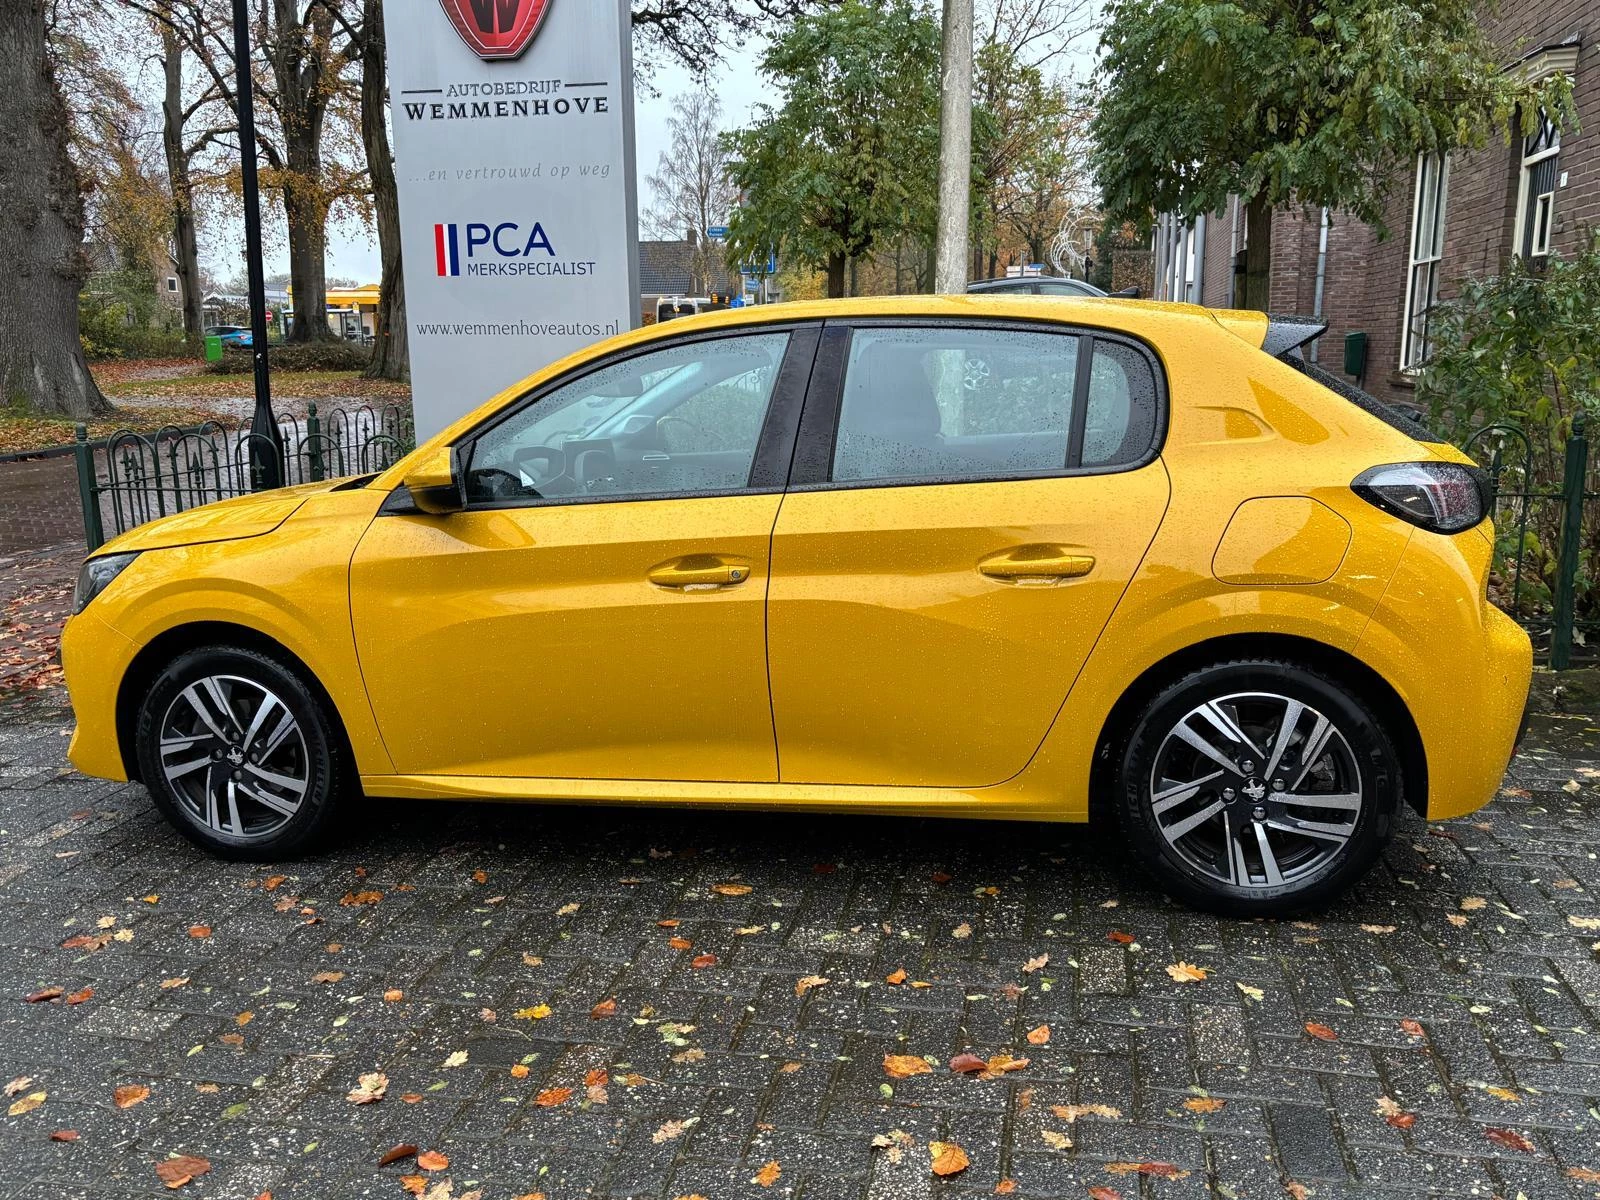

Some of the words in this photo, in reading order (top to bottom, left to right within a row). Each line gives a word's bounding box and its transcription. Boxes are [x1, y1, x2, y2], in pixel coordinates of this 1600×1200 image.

[446, 80, 562, 97] AUTOBEDRIJF
[402, 97, 609, 120] WEMMENHOVE
[456, 163, 541, 181] vertrouwd
[551, 166, 570, 178] op
[579, 163, 610, 177] weg
[466, 222, 556, 257] PCA
[467, 262, 596, 276] MERKSPECIALIST
[416, 320, 619, 336] www.wemmenhoveautos.nl
